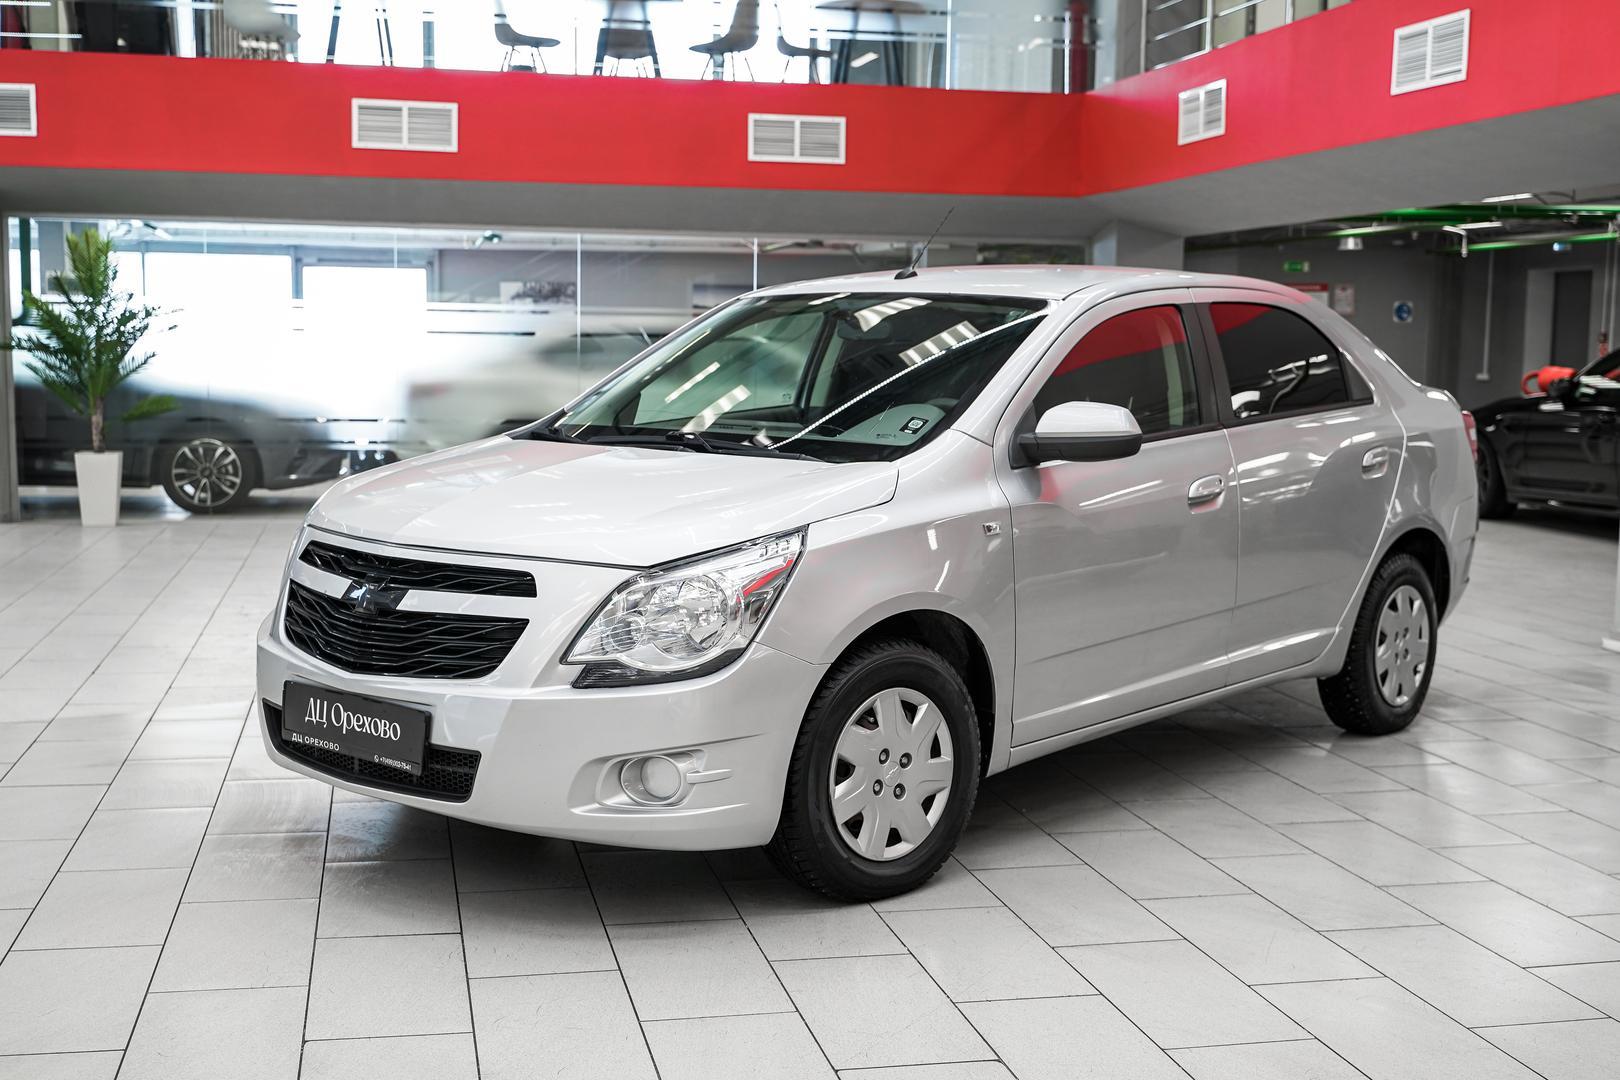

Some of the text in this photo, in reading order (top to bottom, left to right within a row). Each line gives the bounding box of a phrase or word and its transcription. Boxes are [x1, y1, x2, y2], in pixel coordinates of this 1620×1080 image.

[305, 697, 400, 741] ДЦ Орехово
[292, 733, 340, 751] ДЦ ОРЕХОВО
